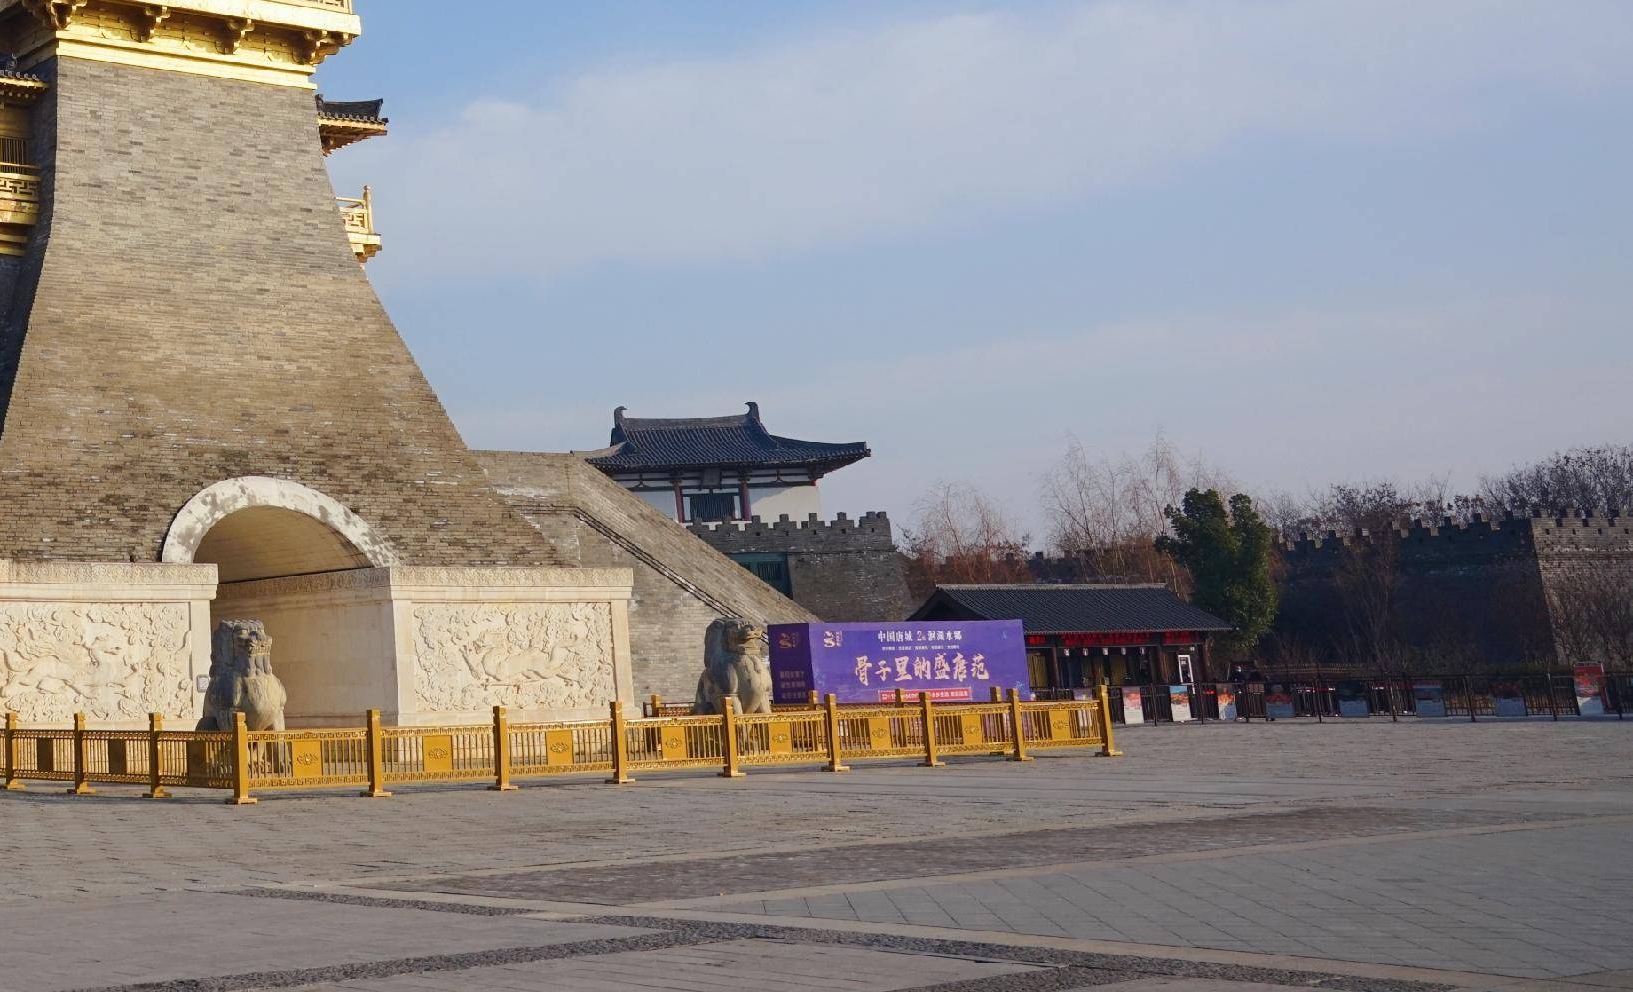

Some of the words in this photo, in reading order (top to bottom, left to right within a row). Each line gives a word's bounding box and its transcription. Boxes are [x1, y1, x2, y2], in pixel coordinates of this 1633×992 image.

[854, 652, 990, 686] 骨子里的盛唐范
